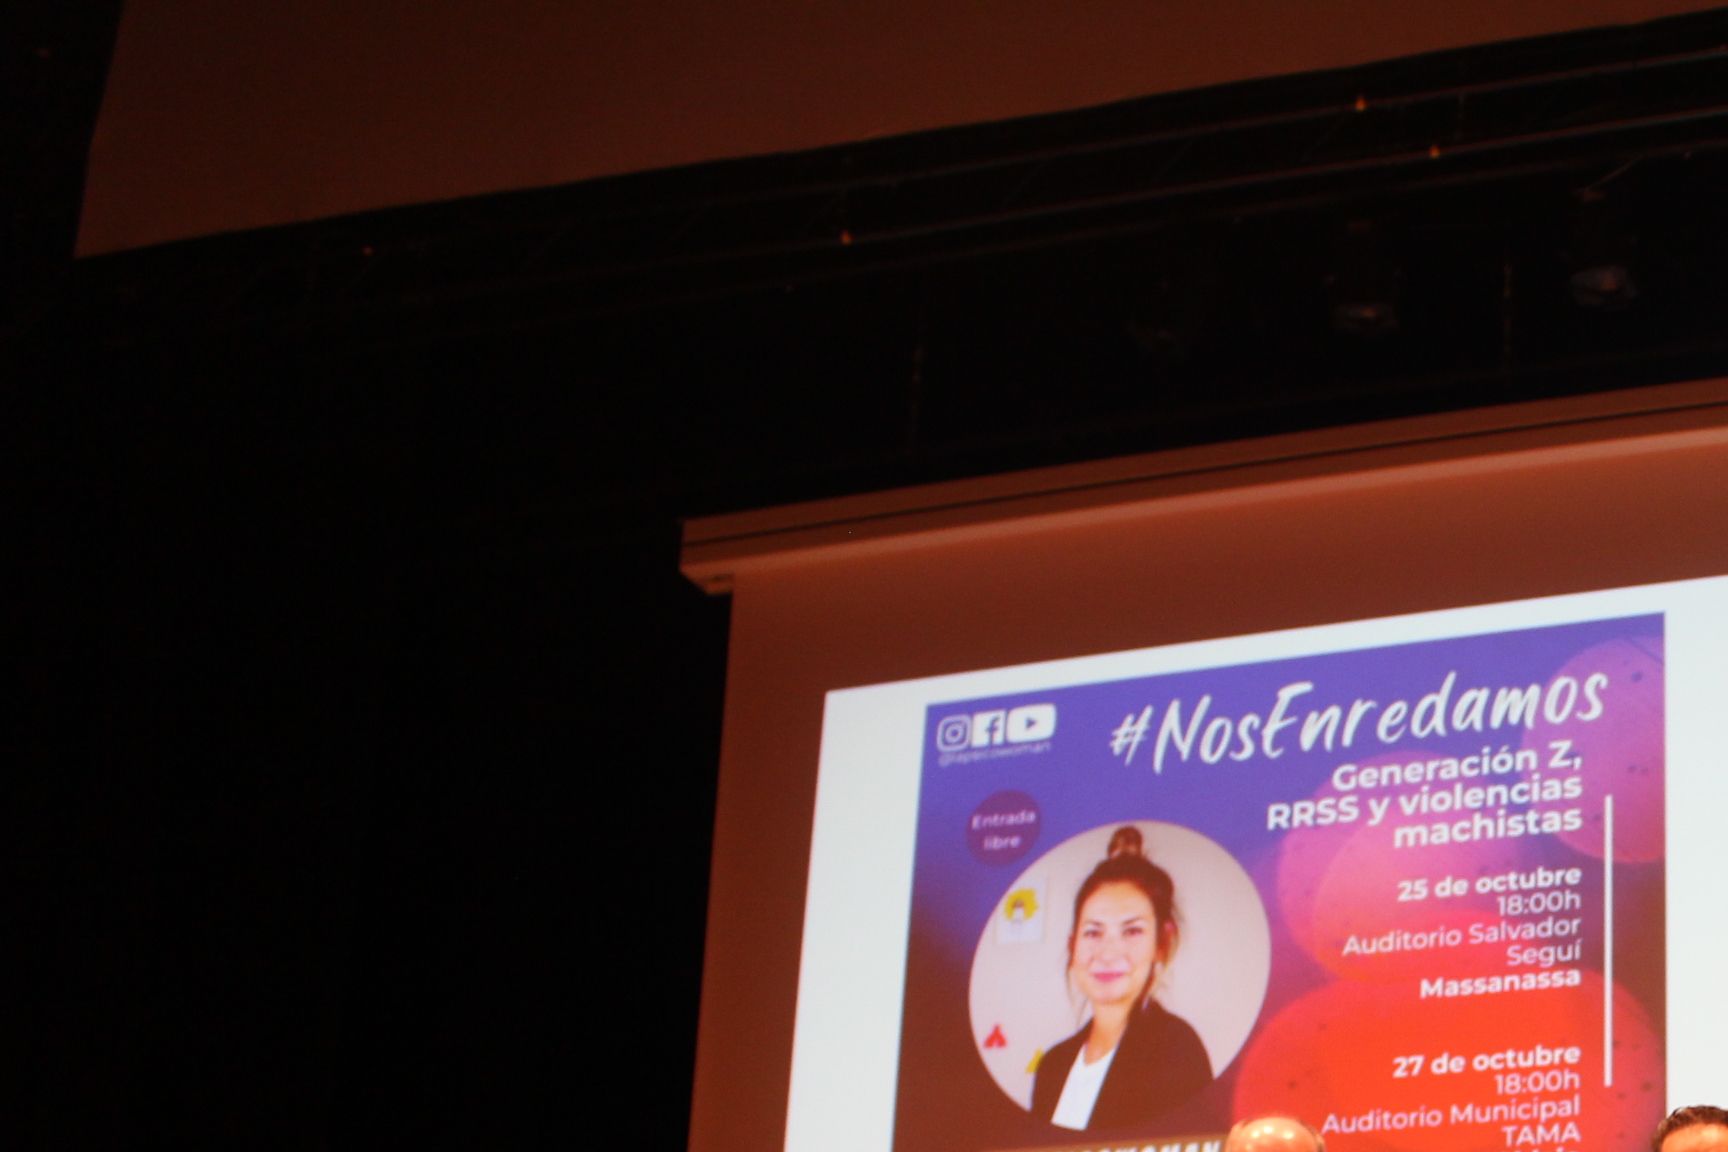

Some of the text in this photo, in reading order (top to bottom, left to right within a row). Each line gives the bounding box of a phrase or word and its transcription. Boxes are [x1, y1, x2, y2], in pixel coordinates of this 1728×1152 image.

[1109, 671, 1608, 775] #NosEnredamos
[1332, 740, 1583, 791] Generación Z,
[972, 810, 1036, 829] Entrada
[1267, 775, 1583, 831] RRSS y violencias
[984, 835, 1021, 850] libre
[1394, 807, 1583, 849] machistas
[1398, 866, 1582, 902] 25 de octubre
[1497, 890, 1581, 916] 18:00h
[1341, 917, 1582, 957] Auditorio Salvador
[1506, 939, 1582, 967] Seguí
[1420, 968, 1582, 999] Massanassa
[1392, 1044, 1581, 1078] 27 de octubre
[1494, 1069, 1580, 1094] 18:00h
[1321, 1094, 1580, 1134] Auditorio Municipal
[1502, 1121, 1581, 1147] TAMA
